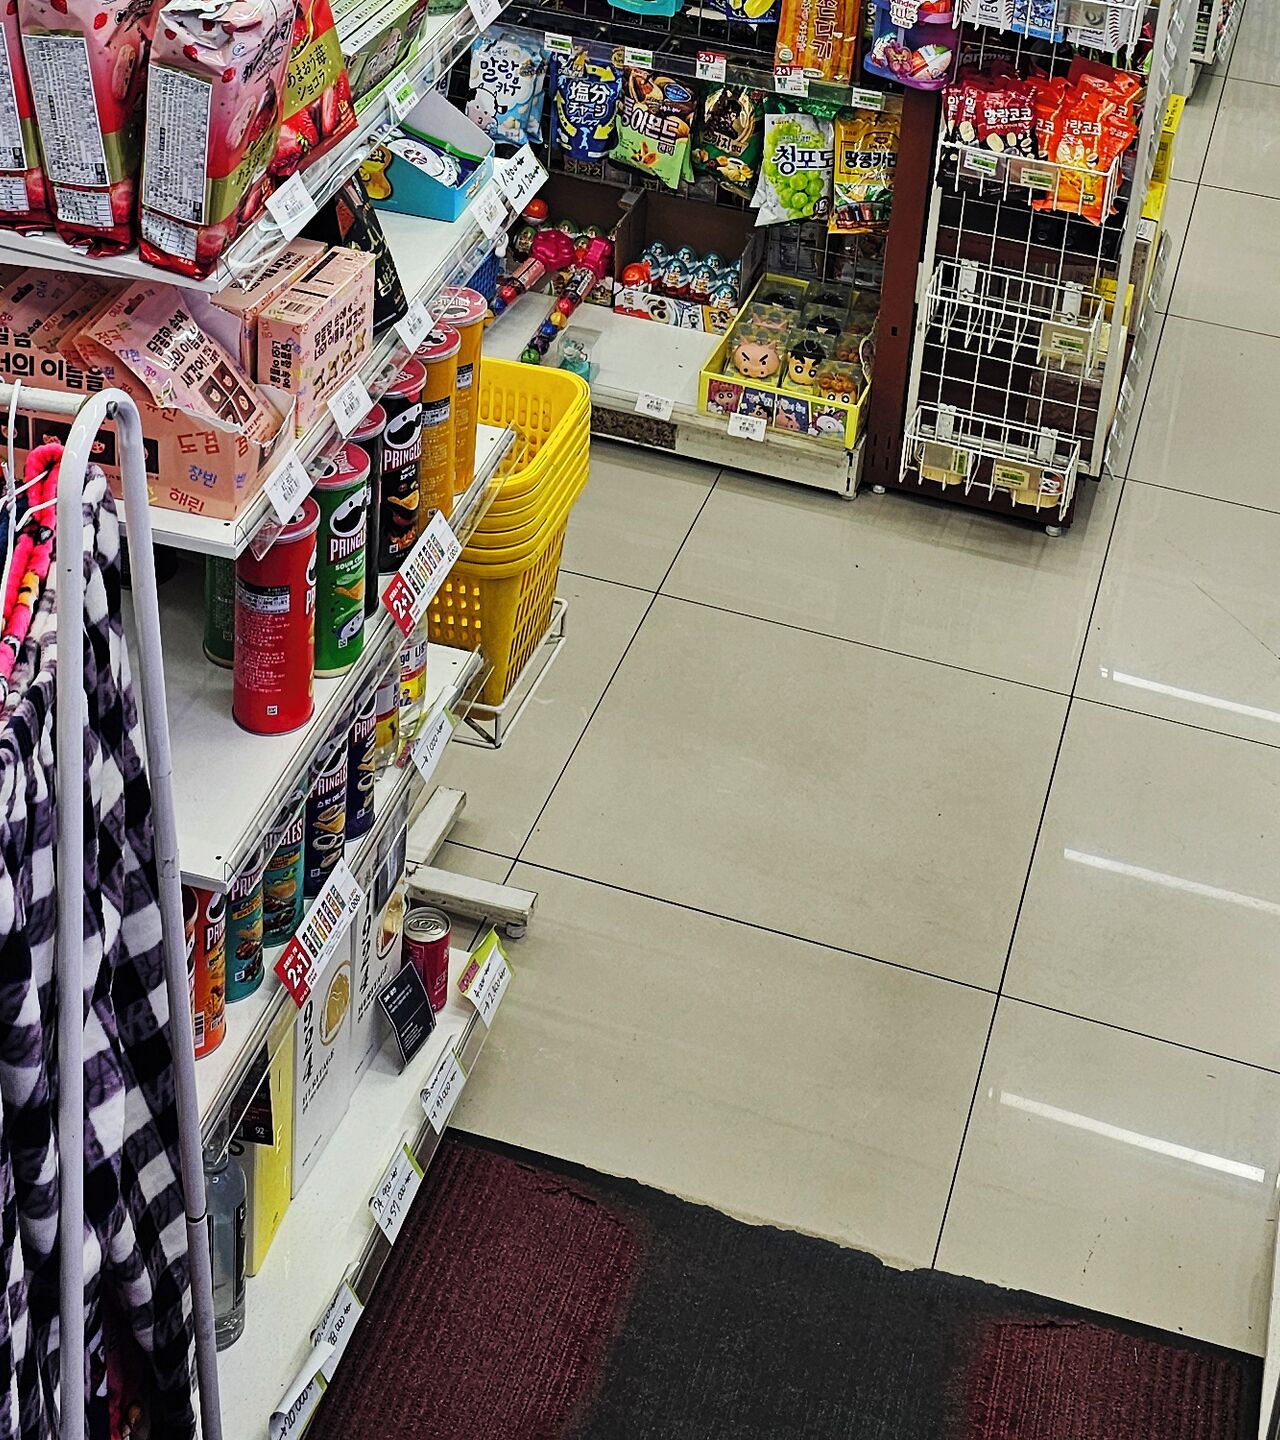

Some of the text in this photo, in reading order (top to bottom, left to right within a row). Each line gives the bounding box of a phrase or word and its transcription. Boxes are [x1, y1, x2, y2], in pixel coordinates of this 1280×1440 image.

[480, 59, 520, 82] 말랑
[569, 81, 610, 103] 塩分
[568, 100, 607, 117] チャージ
[177, 430, 220, 454] 도겸
[391, 587, 416, 620] 2+1
[286, 951, 312, 989] 2+1
